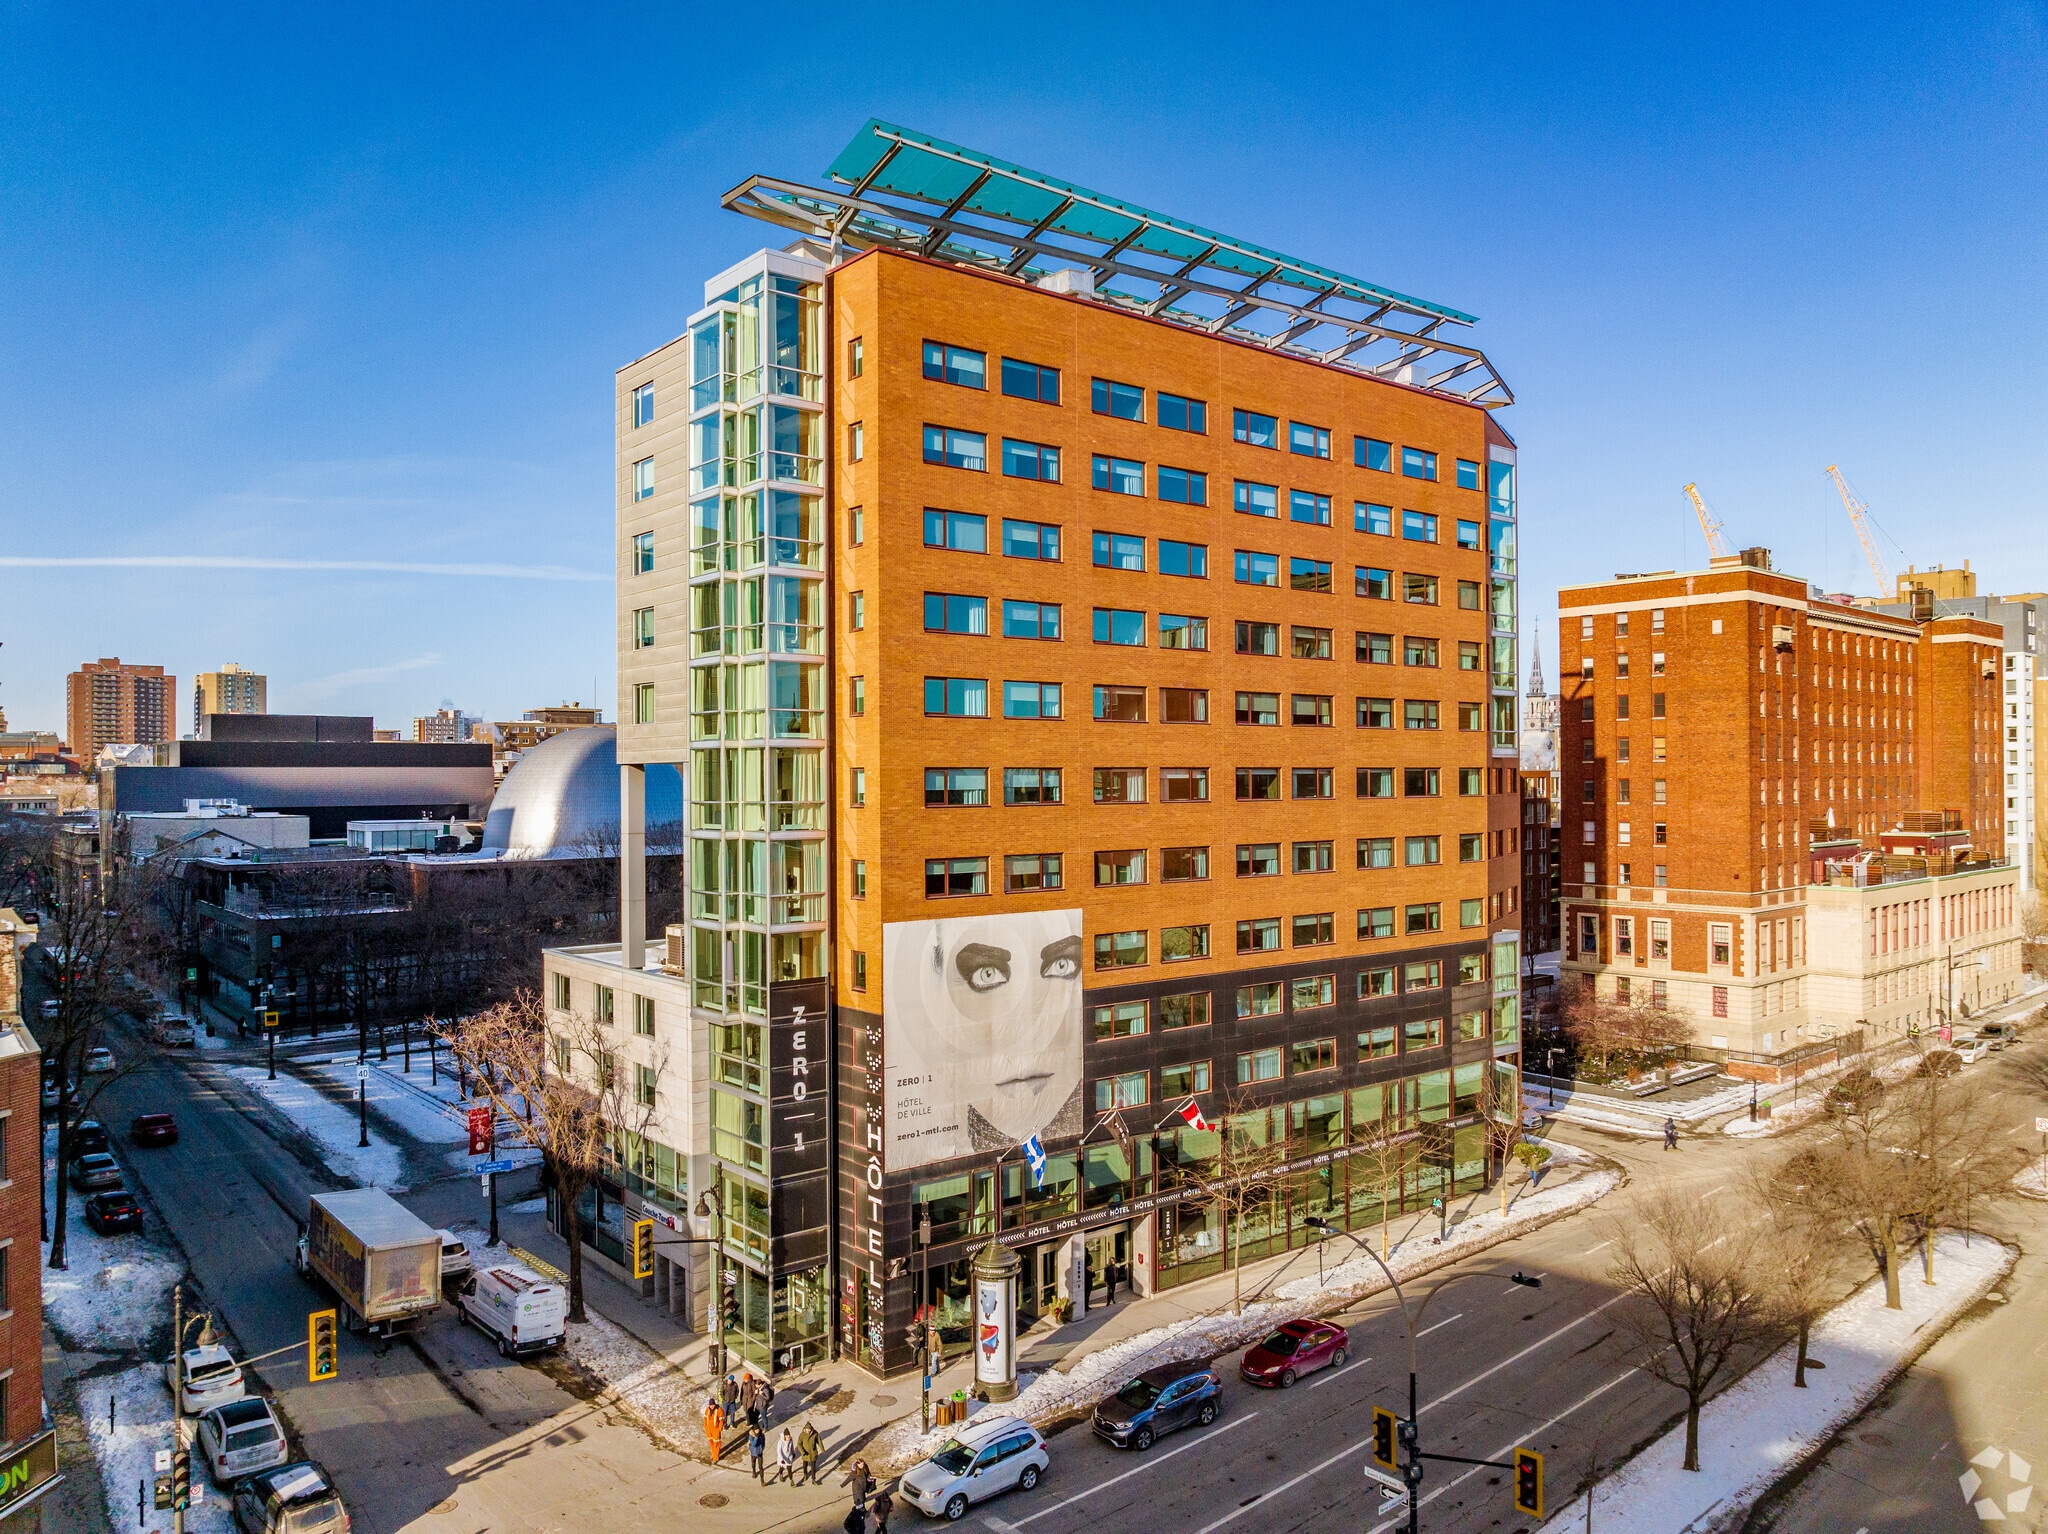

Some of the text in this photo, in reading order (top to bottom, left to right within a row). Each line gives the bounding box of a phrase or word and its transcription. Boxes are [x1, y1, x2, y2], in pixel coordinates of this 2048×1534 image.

[358, 1069, 368, 1077] 40
[897, 1074, 932, 1087] ZERO 1
[897, 1097, 923, 1108] HÔTEL
[897, 1106, 932, 1120] DE VILLE
[897, 1124, 959, 1141] zero1-mtl.com
[867, 1123, 883, 1289] HÔTEL
[1028, 1226, 1050, 1237] HÔTEL
[1057, 1219, 1078, 1230] HÔTEL
[1109, 1206, 1130, 1217] HÔTEL
[1134, 1200, 1154, 1211] HÔTEL
